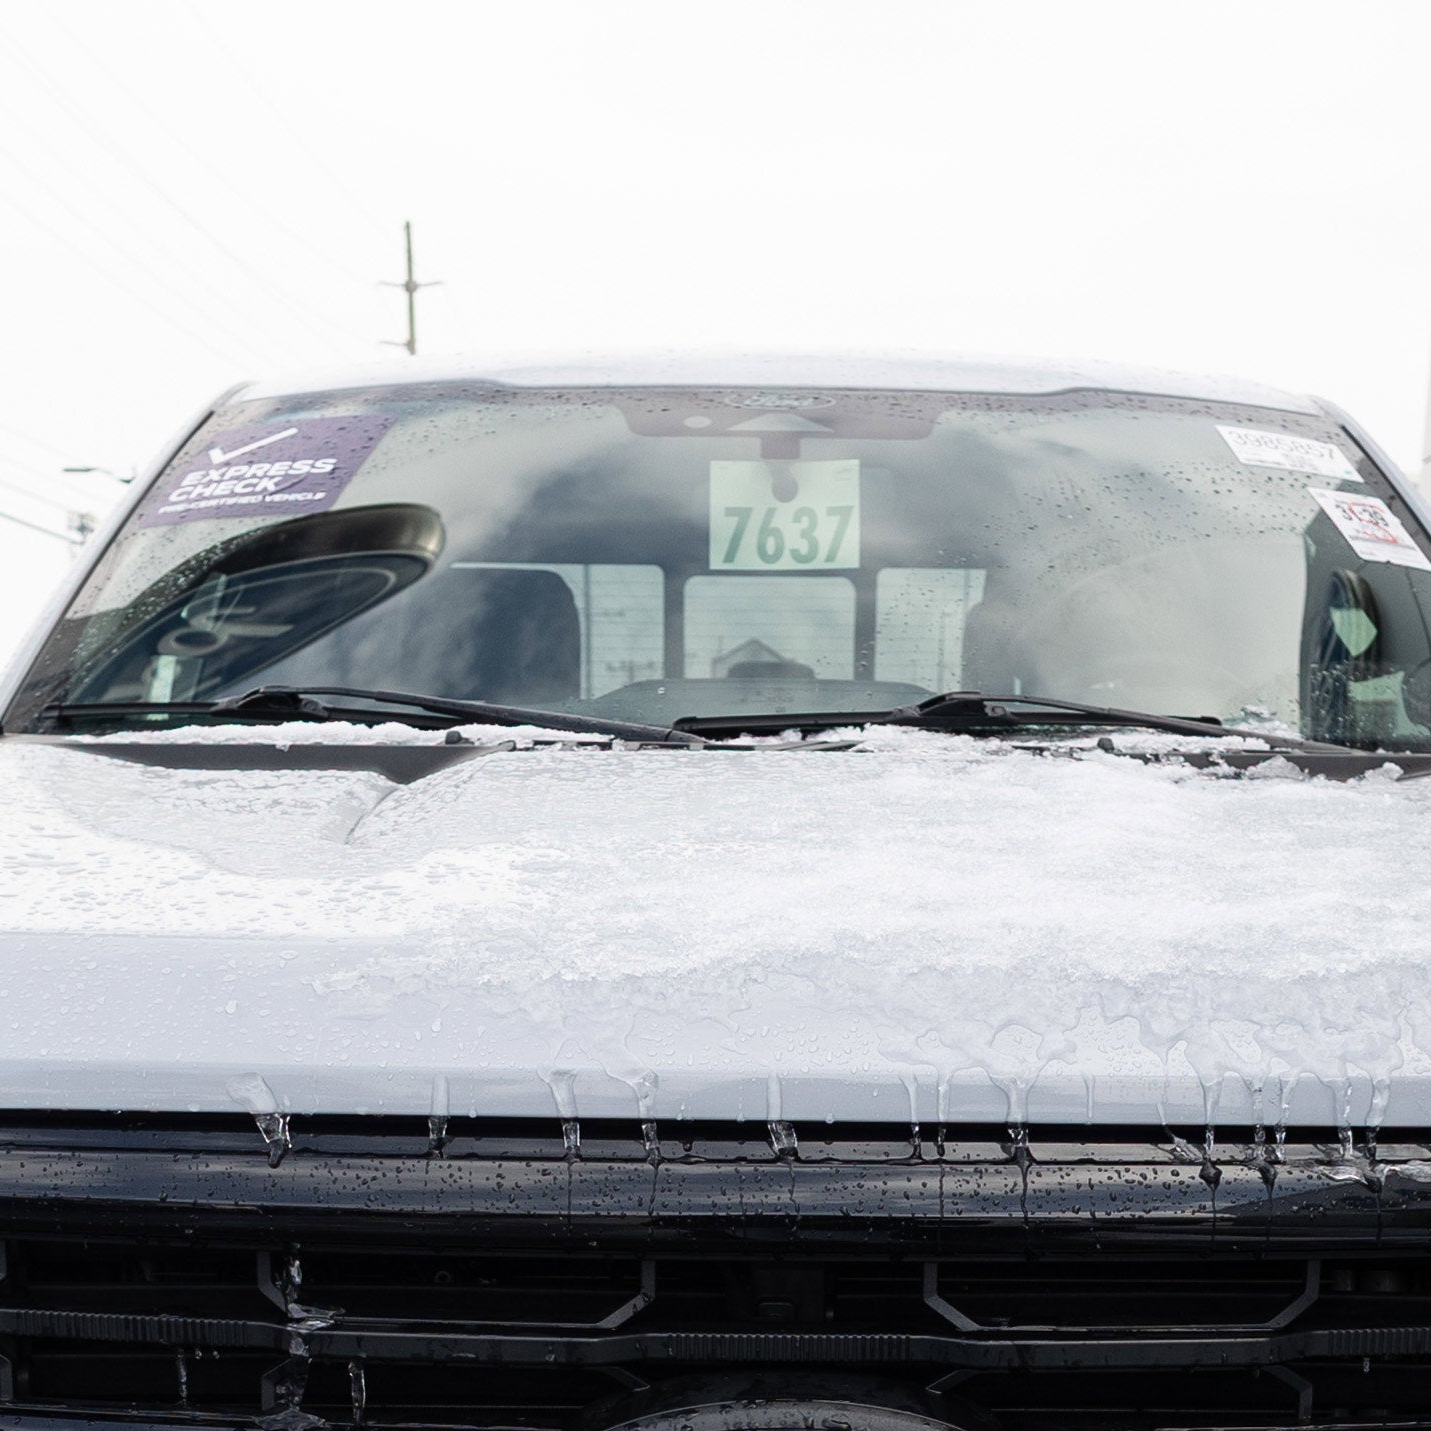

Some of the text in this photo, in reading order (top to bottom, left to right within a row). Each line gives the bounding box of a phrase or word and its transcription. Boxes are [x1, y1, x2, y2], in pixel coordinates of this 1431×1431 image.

[180, 458, 338, 487] EXPRESS
[168, 476, 284, 502] CHECK
[265, 492, 327, 503] VEHICLE
[722, 505, 855, 564] 7637
